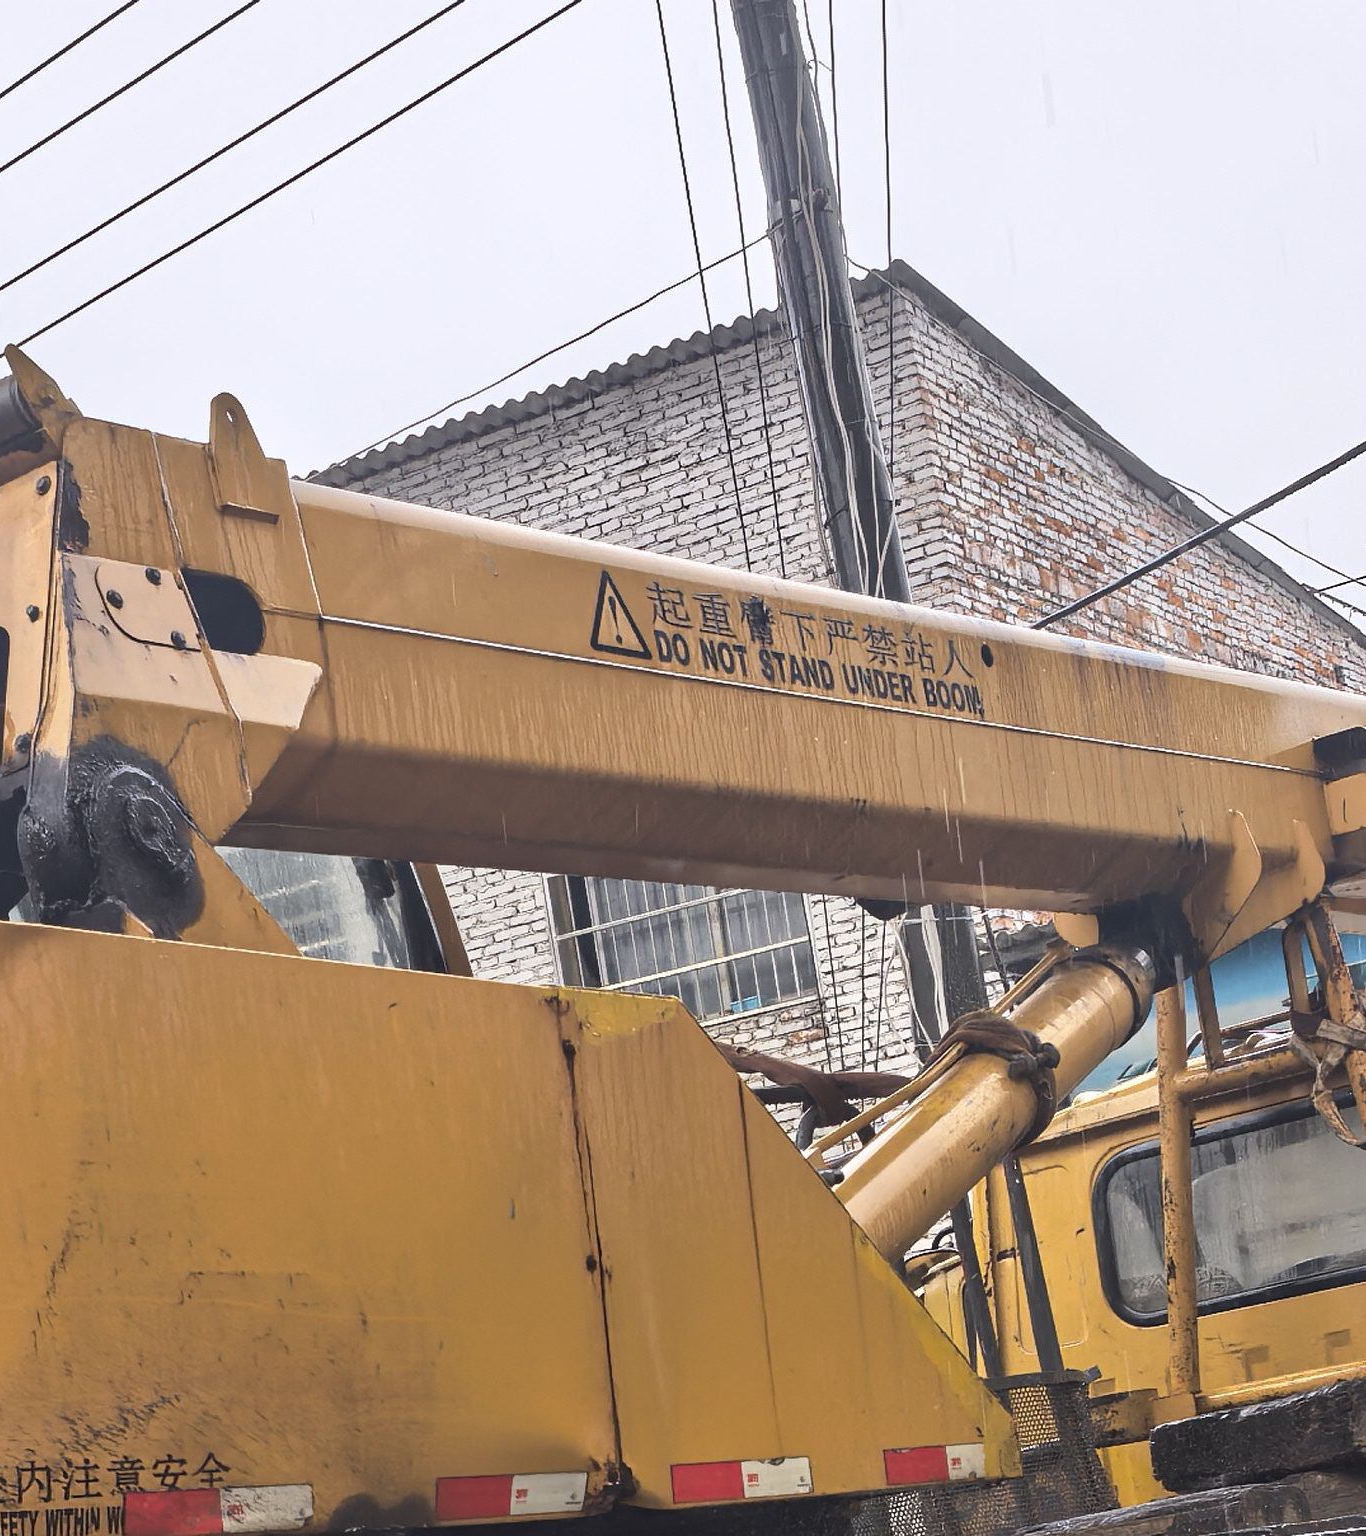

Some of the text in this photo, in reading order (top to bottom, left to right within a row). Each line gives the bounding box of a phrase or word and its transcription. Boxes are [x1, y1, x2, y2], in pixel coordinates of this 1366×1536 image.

[653, 629, 691, 667] DO
[699, 637, 748, 678] NOT
[758, 648, 835, 691] STAND
[841, 662, 917, 704] UNDER
[107, 1506, 124, 1535] W
